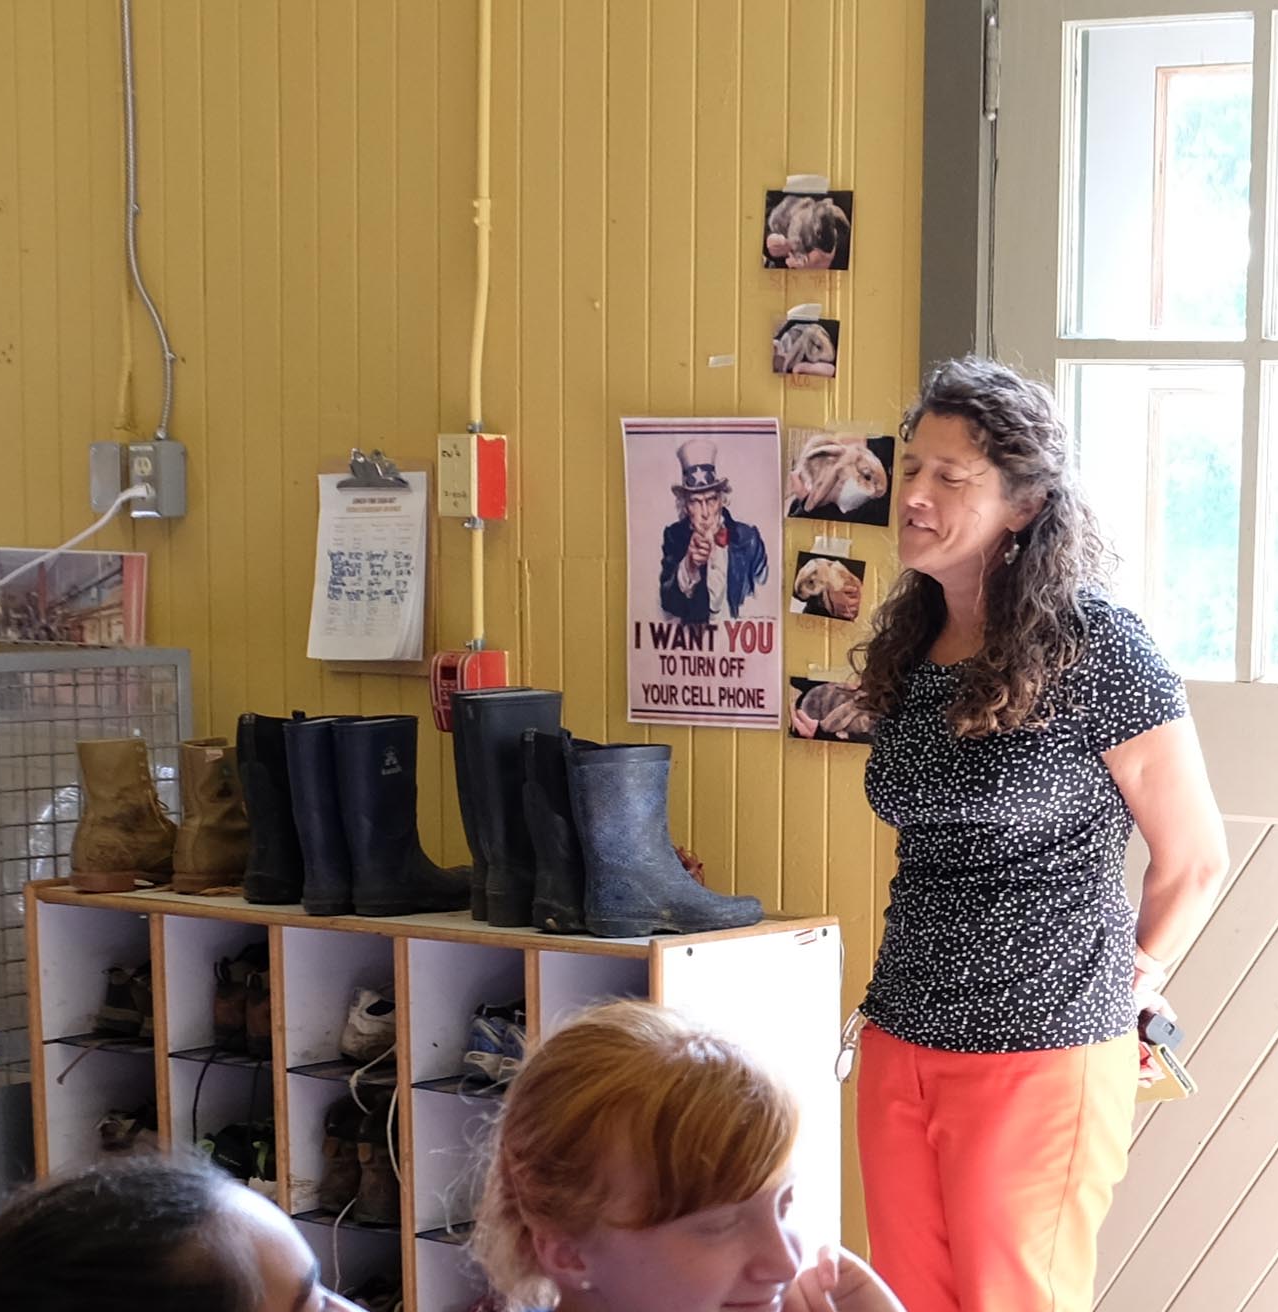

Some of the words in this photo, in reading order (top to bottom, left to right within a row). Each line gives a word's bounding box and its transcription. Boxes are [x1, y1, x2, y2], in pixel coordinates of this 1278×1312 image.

[634, 622, 642, 650] I
[649, 623, 718, 651] WANT
[724, 621, 774, 654] YOU
[659, 655, 677, 676] TO
[681, 656, 716, 678] TURN
[719, 657, 746, 679] OFF
[642, 684, 679, 706] YOUR
[681, 685, 716, 708] CELL
[718, 687, 765, 710] PHONE
